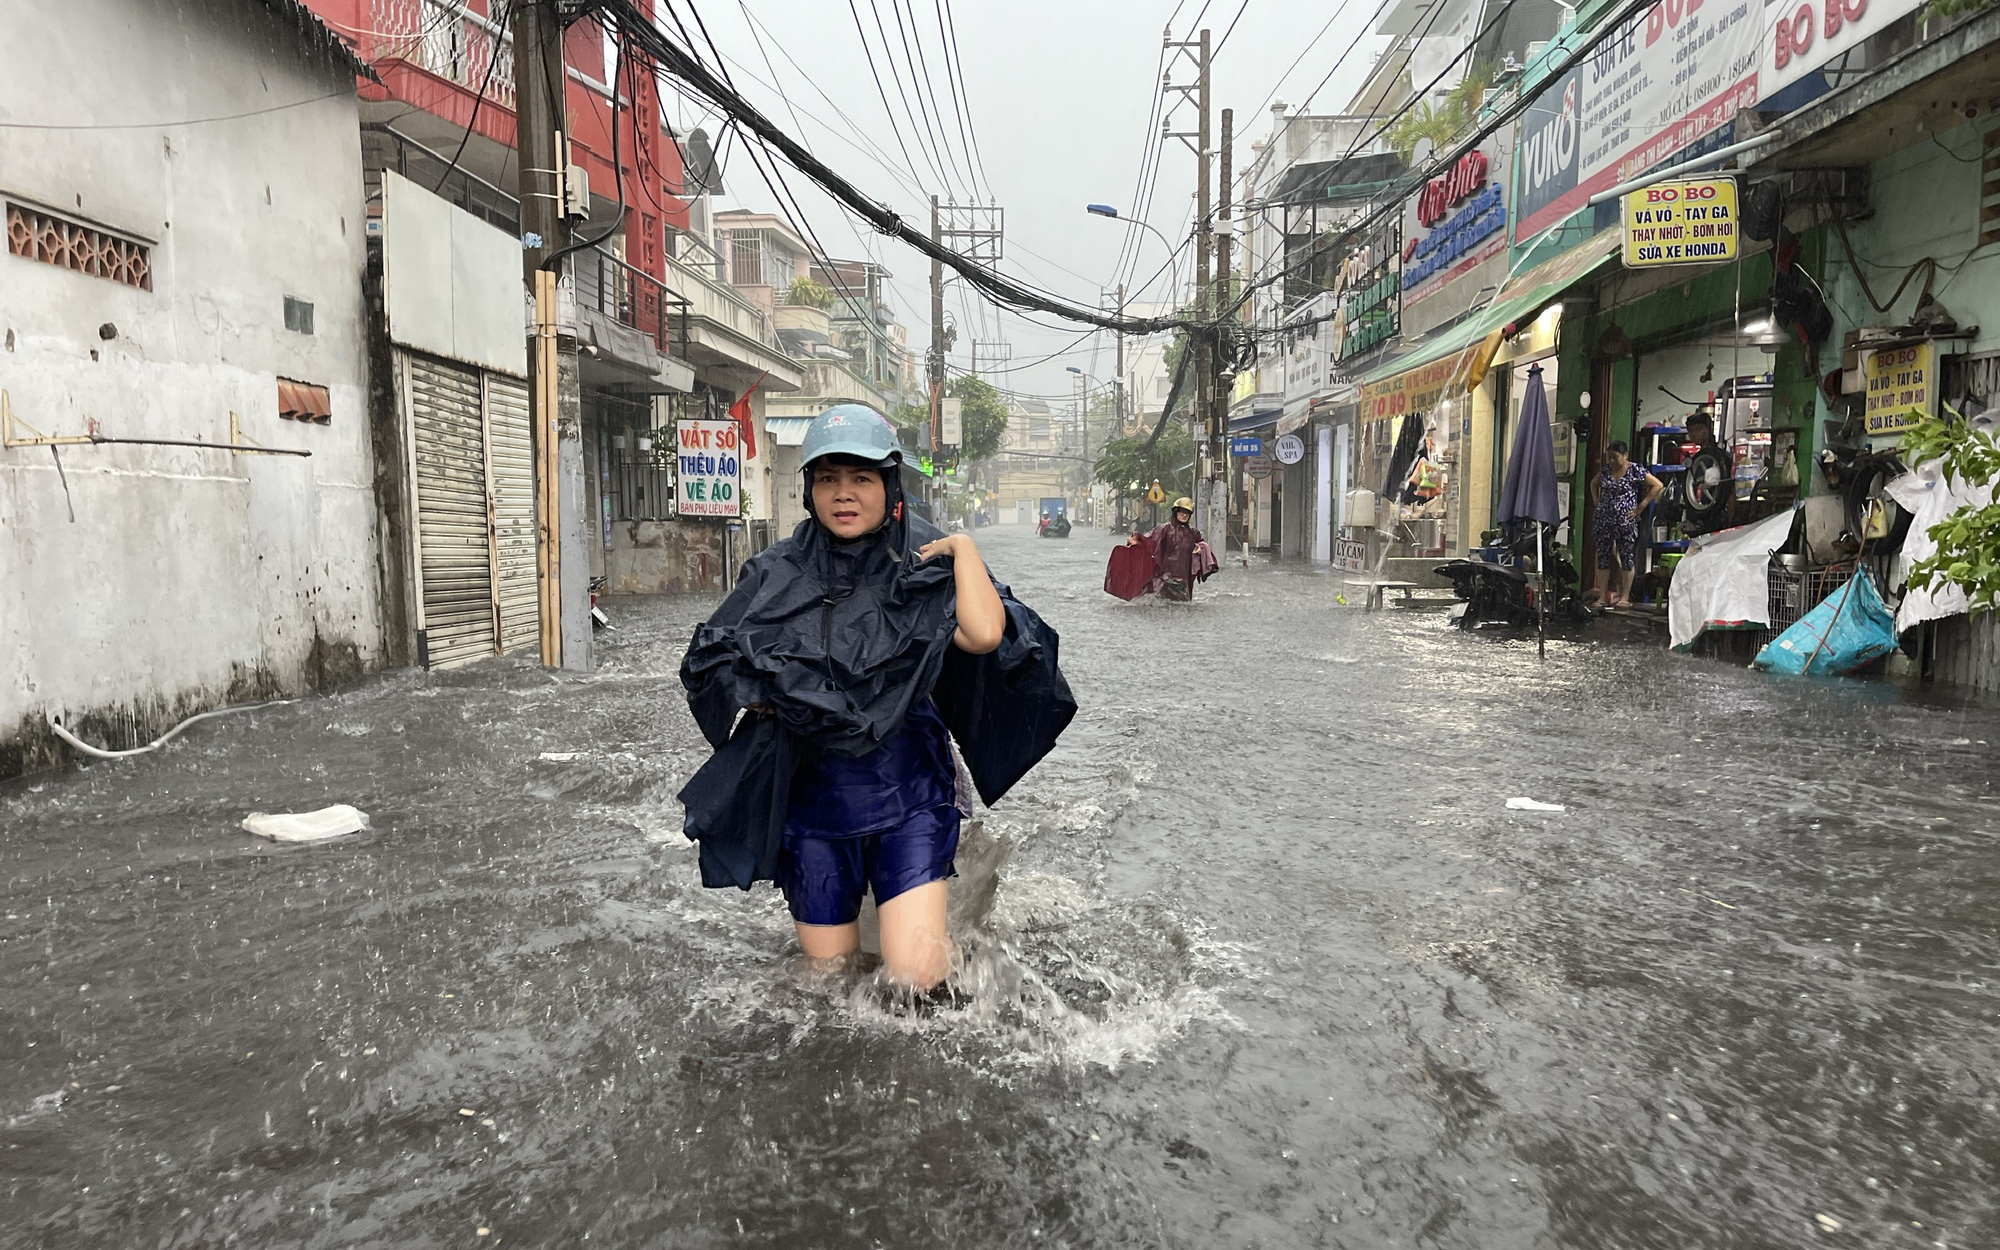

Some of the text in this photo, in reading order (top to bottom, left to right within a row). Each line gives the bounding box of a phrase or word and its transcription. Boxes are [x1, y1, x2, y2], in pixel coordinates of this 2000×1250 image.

[1775, 3, 1814, 70] BO
[1523, 77, 1576, 197] YUKO
[1646, 186, 1716, 203] BO BO
[1635, 208, 1652, 224] VÁ
[1656, 205, 1672, 222] VỎ
[1685, 207, 1707, 220] TAY
[1712, 206, 1729, 219] GA
[1632, 228, 1656, 242] THAY
[1659, 223, 1683, 240] NHỚT
[1693, 222, 1715, 238] BƠM
[1638, 242, 1727, 260] SỬA XE HONDA
[1877, 348, 1917, 368] BO BO
[1897, 371, 1911, 387] TAY
[1913, 369, 1923, 384] GA
[1389, 391, 1405, 415] BO
[1868, 396, 1880, 411] THAY
[1884, 415, 1893, 428] XE
[715, 422, 738, 450] SỔ
[1250, 444, 1259, 452] 35
[1281, 441, 1296, 450] NAIL
[1284, 450, 1298, 459] SPA
[679, 452, 738, 477] THÊU ÁO
[685, 478, 733, 502] VẼ ÁO
[695, 503, 708, 516] PHỤ
[724, 504, 738, 514] MAY
[1336, 543, 1346, 556] LY
